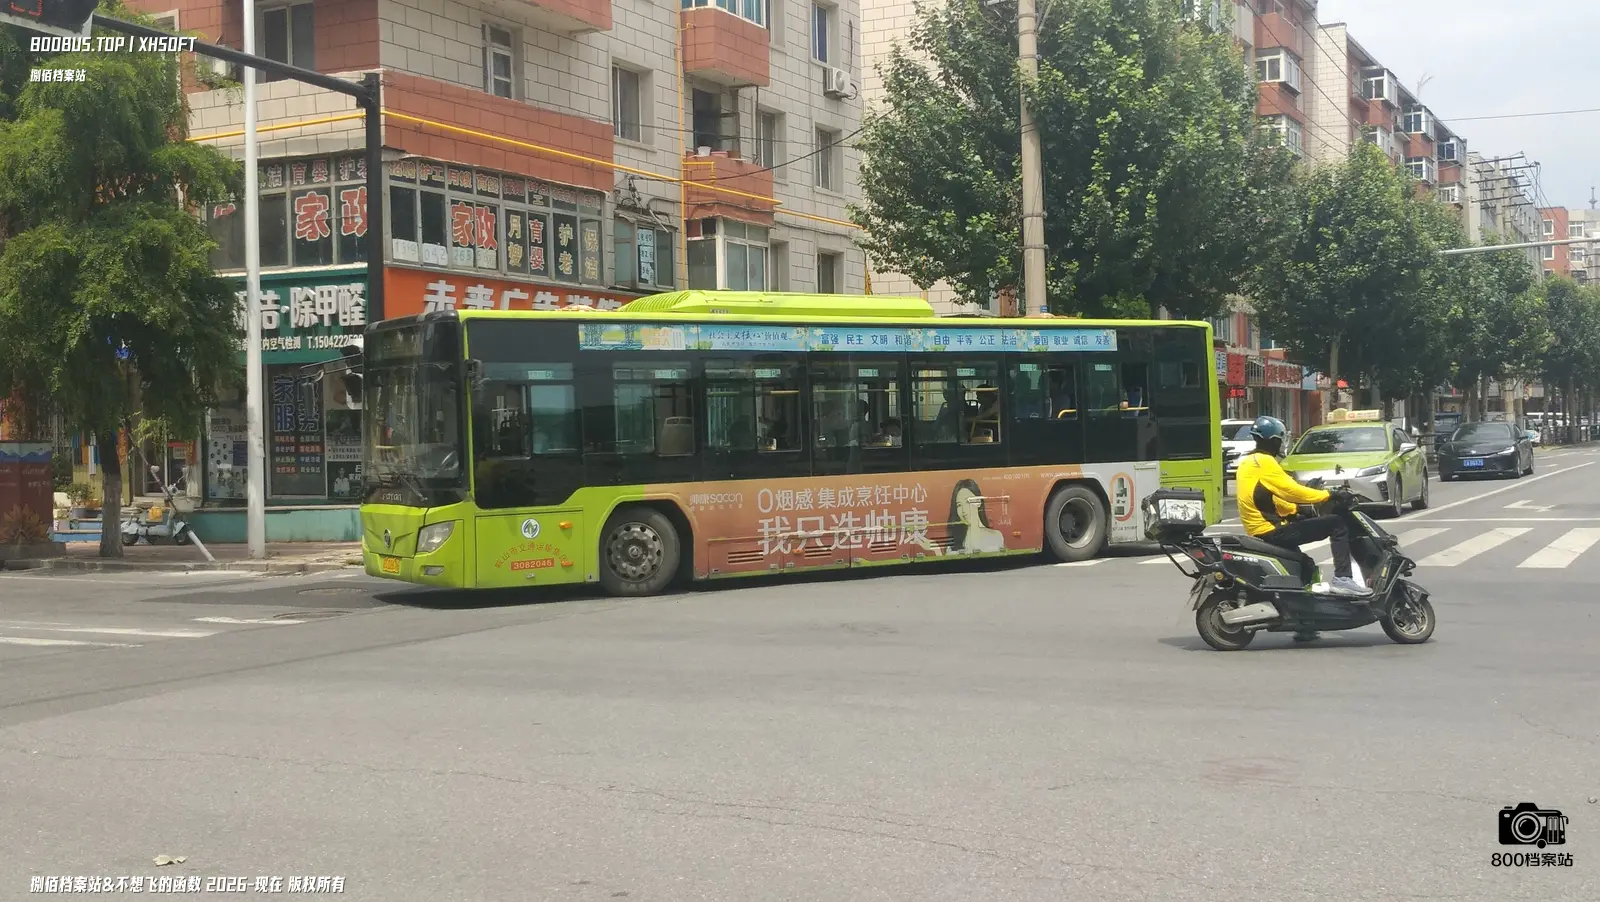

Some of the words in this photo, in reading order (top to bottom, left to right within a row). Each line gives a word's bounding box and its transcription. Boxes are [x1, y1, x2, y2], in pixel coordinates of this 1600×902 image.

[292, 162, 328, 185] 育婴
[294, 186, 368, 242] 家政
[451, 201, 497, 251] 家政
[508, 214, 524, 268] 月嫂
[528, 219, 545, 271] 育婴
[558, 223, 573, 275] 护老
[584, 227, 599, 280] 保洁
[709, 328, 788, 342] 社会主义核心价值观
[821, 334, 839, 345] 富强
[846, 335, 864, 345] 民主
[871, 335, 888, 345] 文明
[895, 335, 912, 346] 和谐
[933, 335, 950, 345] 自由
[956, 335, 972, 345] 平等
[979, 335, 995, 345] 公正
[1001, 335, 1017, 345] 法治
[1033, 336, 1049, 345] 爱国
[1053, 336, 1069, 345] 敬业
[1073, 336, 1089, 345] 诚信
[1095, 336, 1110, 345] 友善
[817, 482, 928, 509] 集成烹饪中心
[757, 507, 930, 556] 我只选帅康
[513, 560, 552, 569] 3082046
